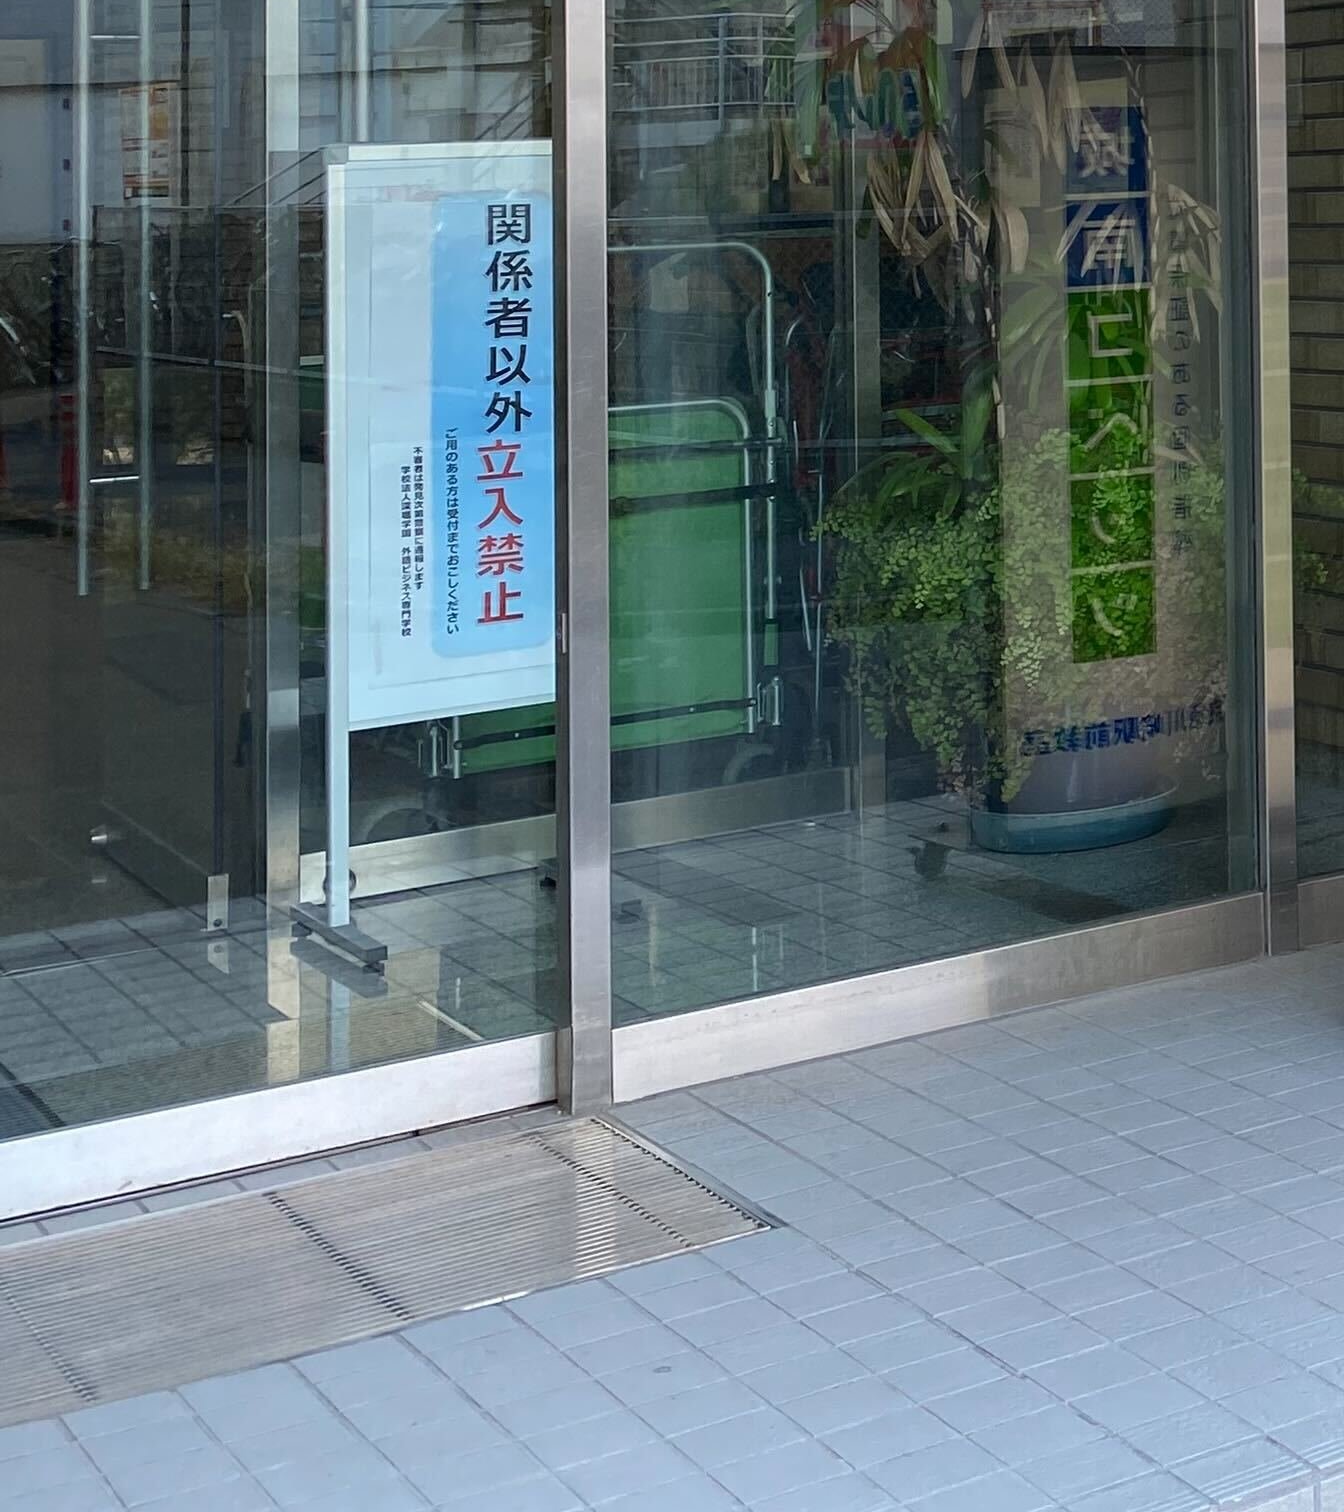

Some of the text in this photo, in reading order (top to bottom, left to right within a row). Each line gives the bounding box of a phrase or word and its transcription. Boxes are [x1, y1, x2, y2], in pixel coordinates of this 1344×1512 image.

[445, 427, 459, 635] ご用のある方は受付までおこしください
[476, 202, 534, 626] 関係者以外立入禁止
